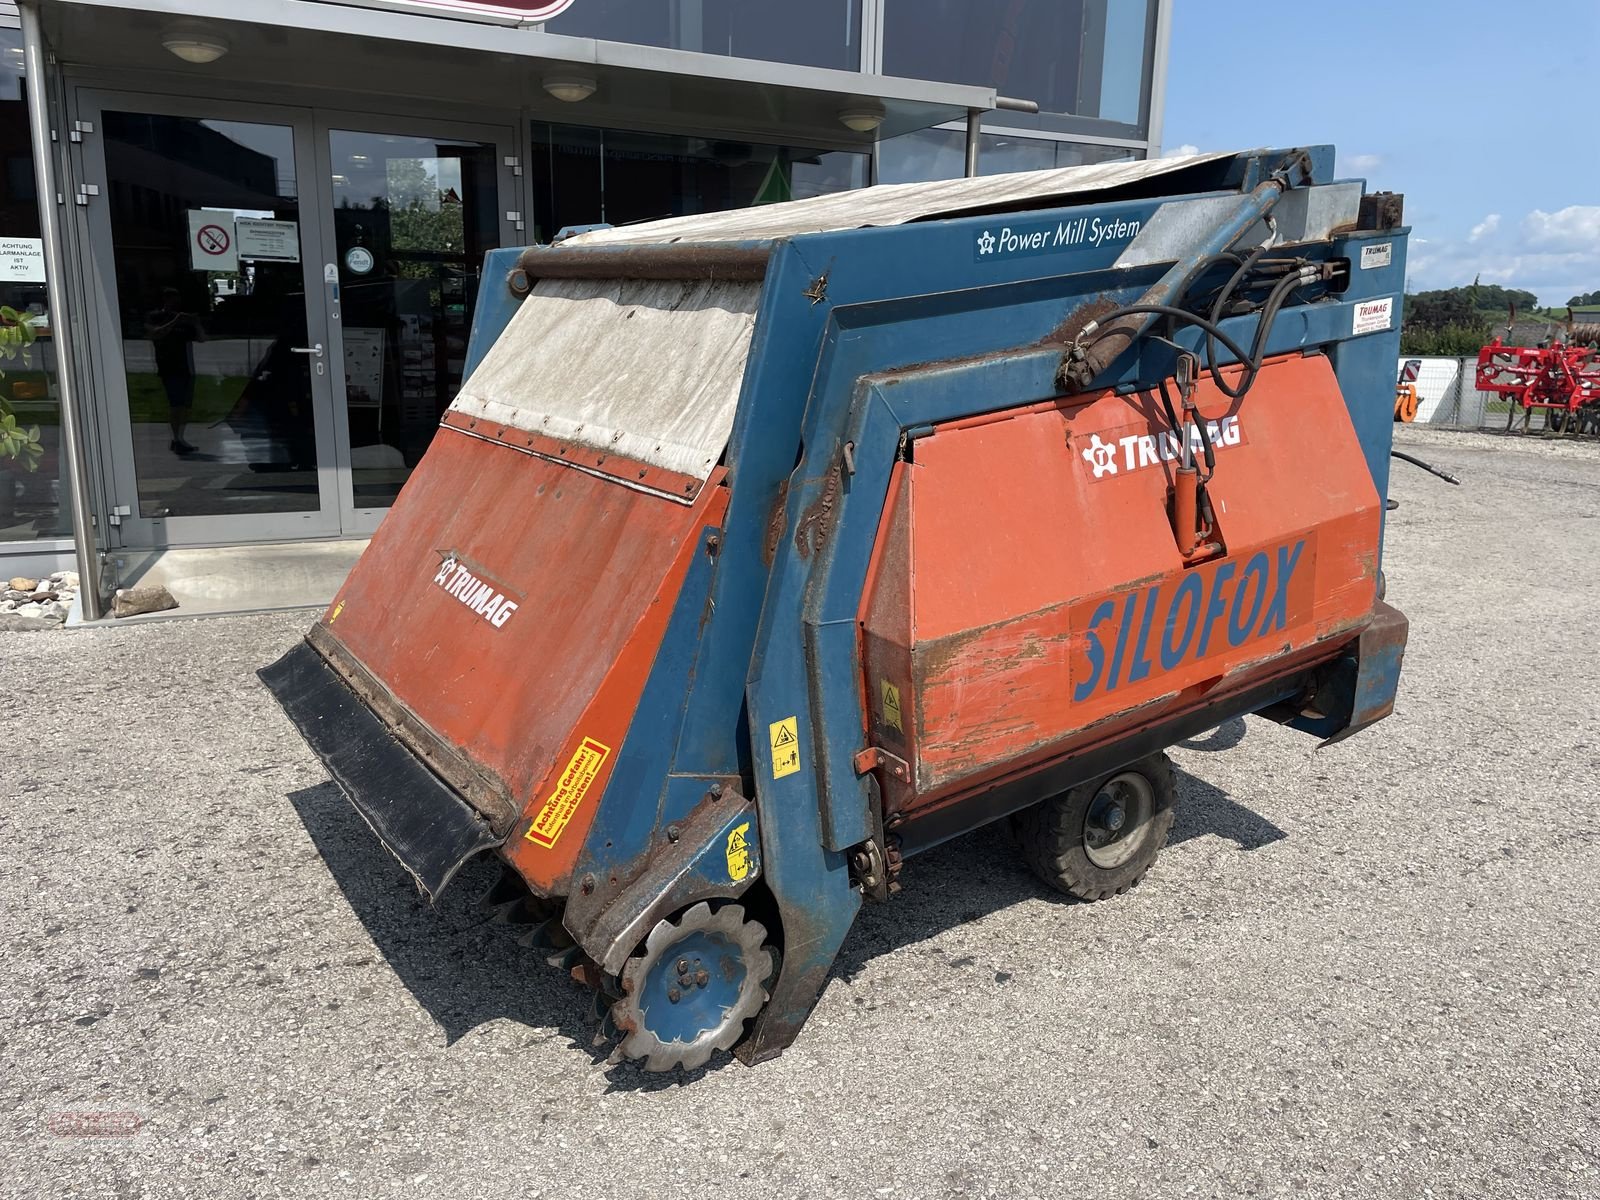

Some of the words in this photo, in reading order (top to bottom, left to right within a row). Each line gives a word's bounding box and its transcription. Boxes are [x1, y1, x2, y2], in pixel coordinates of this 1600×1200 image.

[998, 228, 1050, 253] Power
[1053, 218, 1087, 246] Mill
[1088, 217, 1140, 247] System
[1365, 245, 1388, 255] TRUMAG
[1359, 303, 1388, 317] TRUMAG
[1120, 415, 1241, 471] TRUMAG
[444, 564, 519, 628] TRUMAG
[1073, 540, 1305, 702] SILOFOX
[536, 788, 567, 831] Achtung
[562, 749, 589, 787] Gefahr!
[544, 803, 566, 834] Aufenthalt
[564, 794, 572, 804] im
[568, 753, 596, 796] Arbeitsbereich
[562, 772, 593, 820] verboten!
